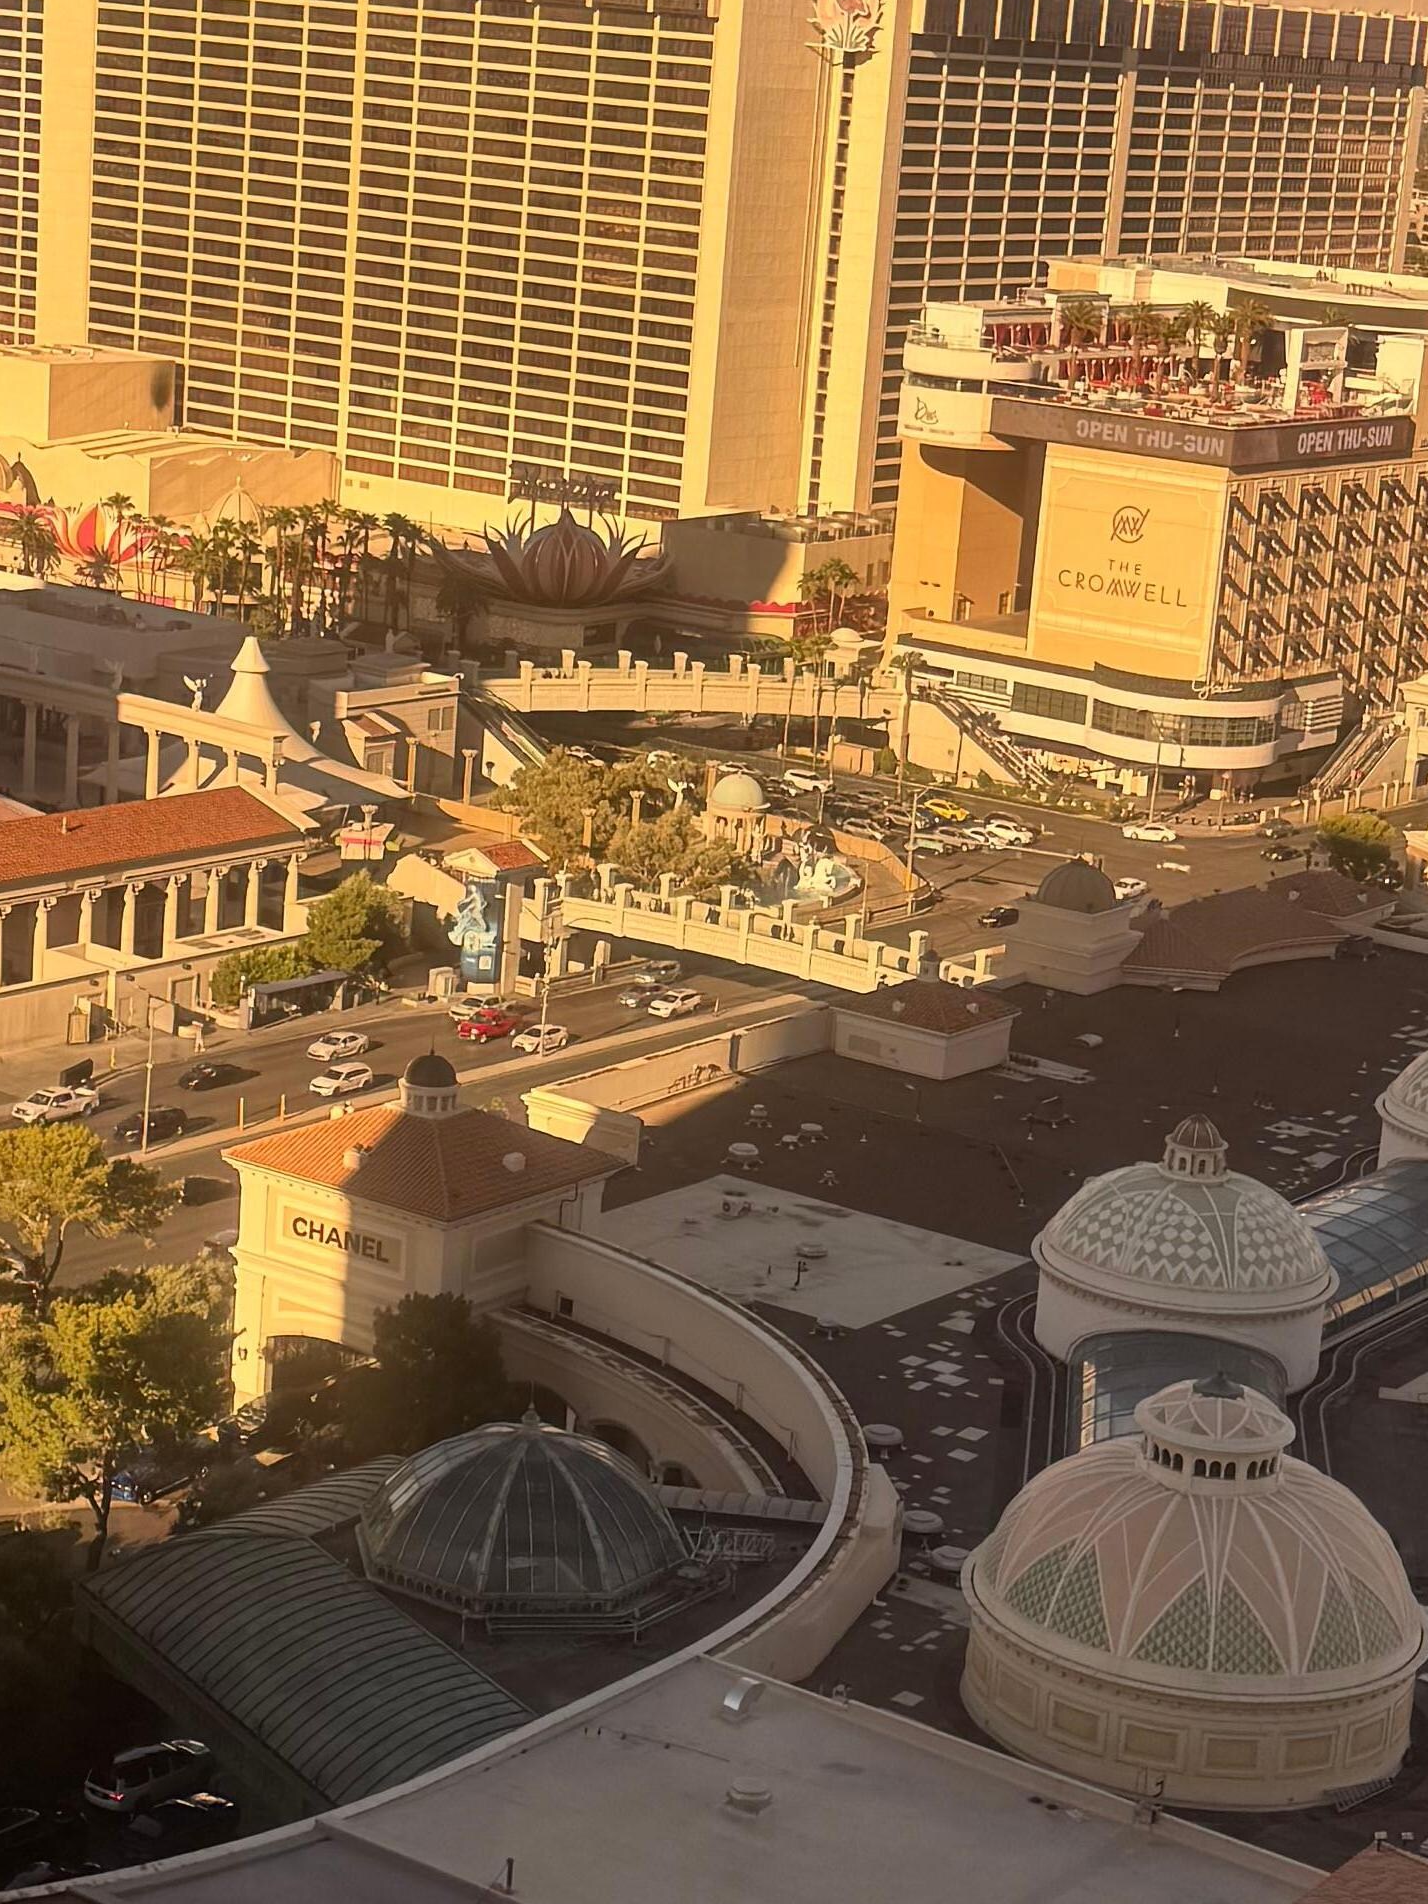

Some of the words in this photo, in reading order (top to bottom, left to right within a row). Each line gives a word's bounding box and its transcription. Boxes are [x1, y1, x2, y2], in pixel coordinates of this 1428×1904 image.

[1075, 419, 1128, 445] OPEN
[1135, 426, 1225, 458] THU-SUN
[1297, 430, 1333, 455] OPEN
[1336, 424, 1394, 448] THU-SUN
[1108, 558, 1143, 576] THE
[1058, 569, 1188, 608] CROMWELL
[292, 1216, 389, 1263] CHANEL
